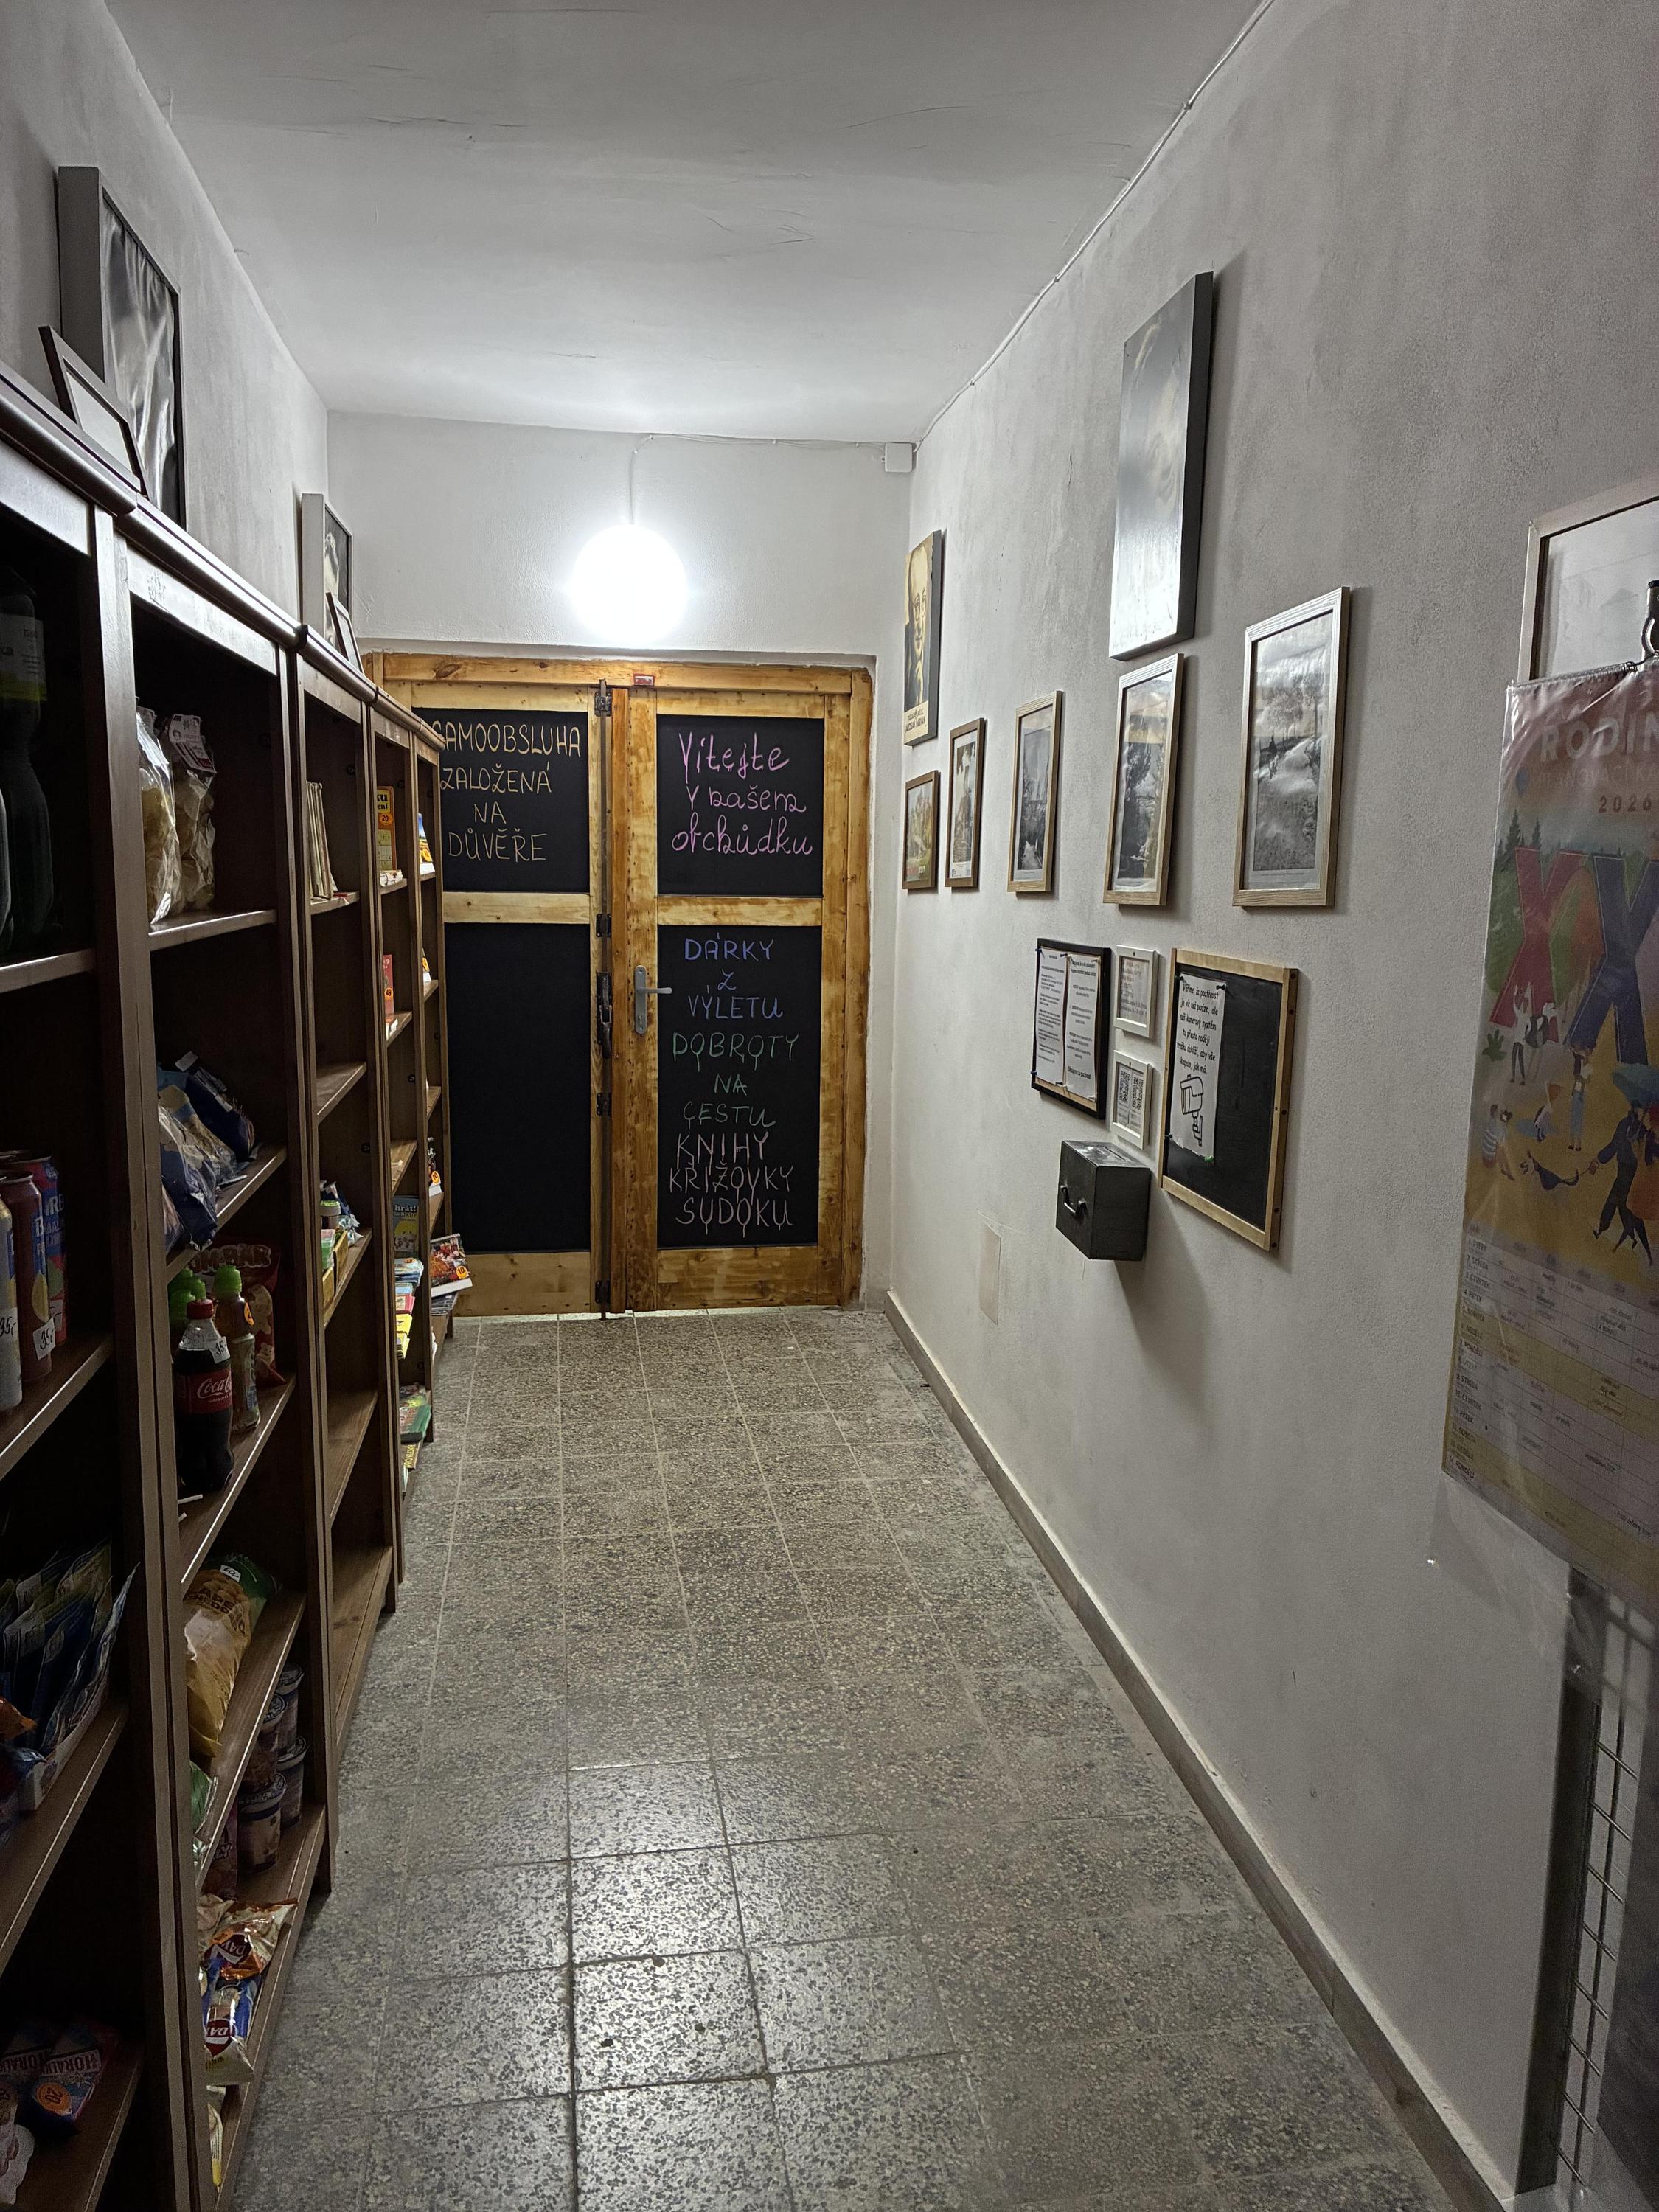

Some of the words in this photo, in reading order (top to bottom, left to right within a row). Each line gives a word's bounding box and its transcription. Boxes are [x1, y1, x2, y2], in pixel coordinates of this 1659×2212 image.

[432, 720, 581, 757] SAMOOBSLUHA
[678, 731, 790, 784] Vítejte
[440, 761, 552, 794] ZALOŽENÁ
[474, 801, 507, 824] NA
[709, 785, 807, 813] našem
[1599, 795, 1652, 813] 2026
[448, 828, 547, 863] DŮVĚŘE
[672, 811, 813, 855] obchůdku
[685, 932, 774, 961] DÁRKY
[688, 984, 783, 1019] VÝLETU
[1200, 989, 1220, 1001] poctivost
[673, 1032, 799, 1072] DOBROTY
[714, 1073, 748, 1096] NA
[683, 1101, 776, 1129] CESTU
[676, 1131, 769, 1172] KNIHY
[675, 1197, 793, 1237] SUDOKU
[458, 1266, 465, 1274] 10
